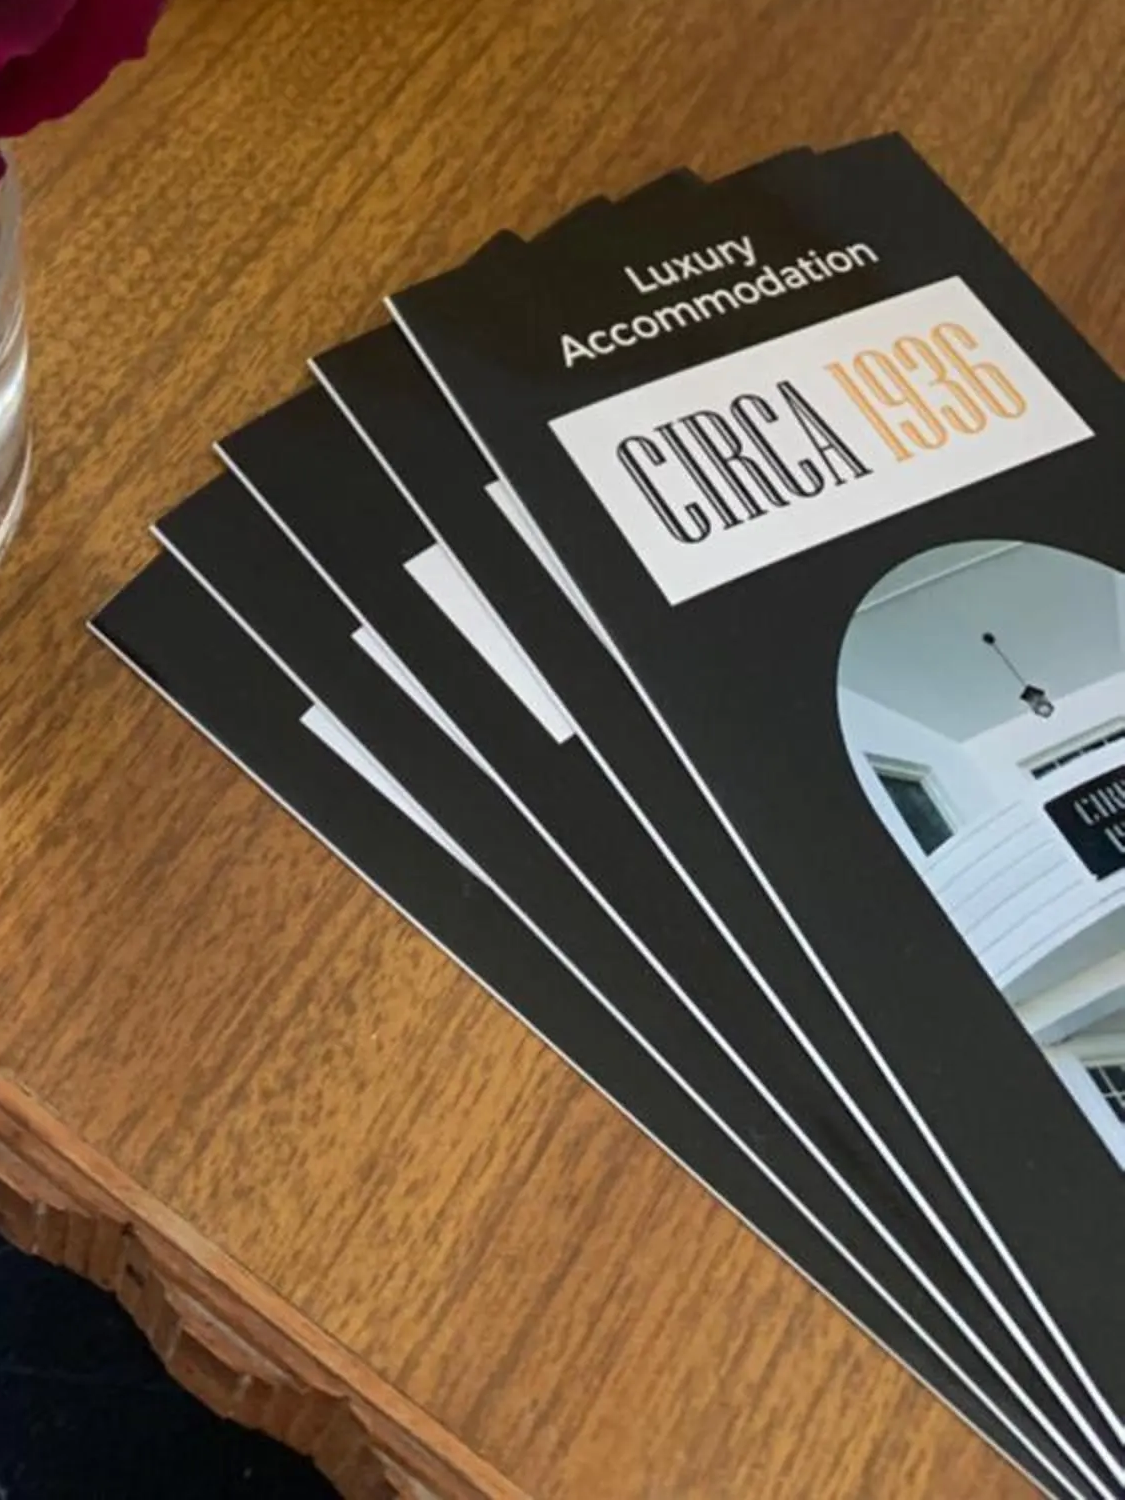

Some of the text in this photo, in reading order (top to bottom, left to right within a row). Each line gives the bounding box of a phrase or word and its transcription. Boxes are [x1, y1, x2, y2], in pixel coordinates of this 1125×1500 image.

[559, 239, 880, 367] Accommodation
[624, 235, 758, 294] Luxury
[615, 322, 1028, 545] CIRCA 1936
